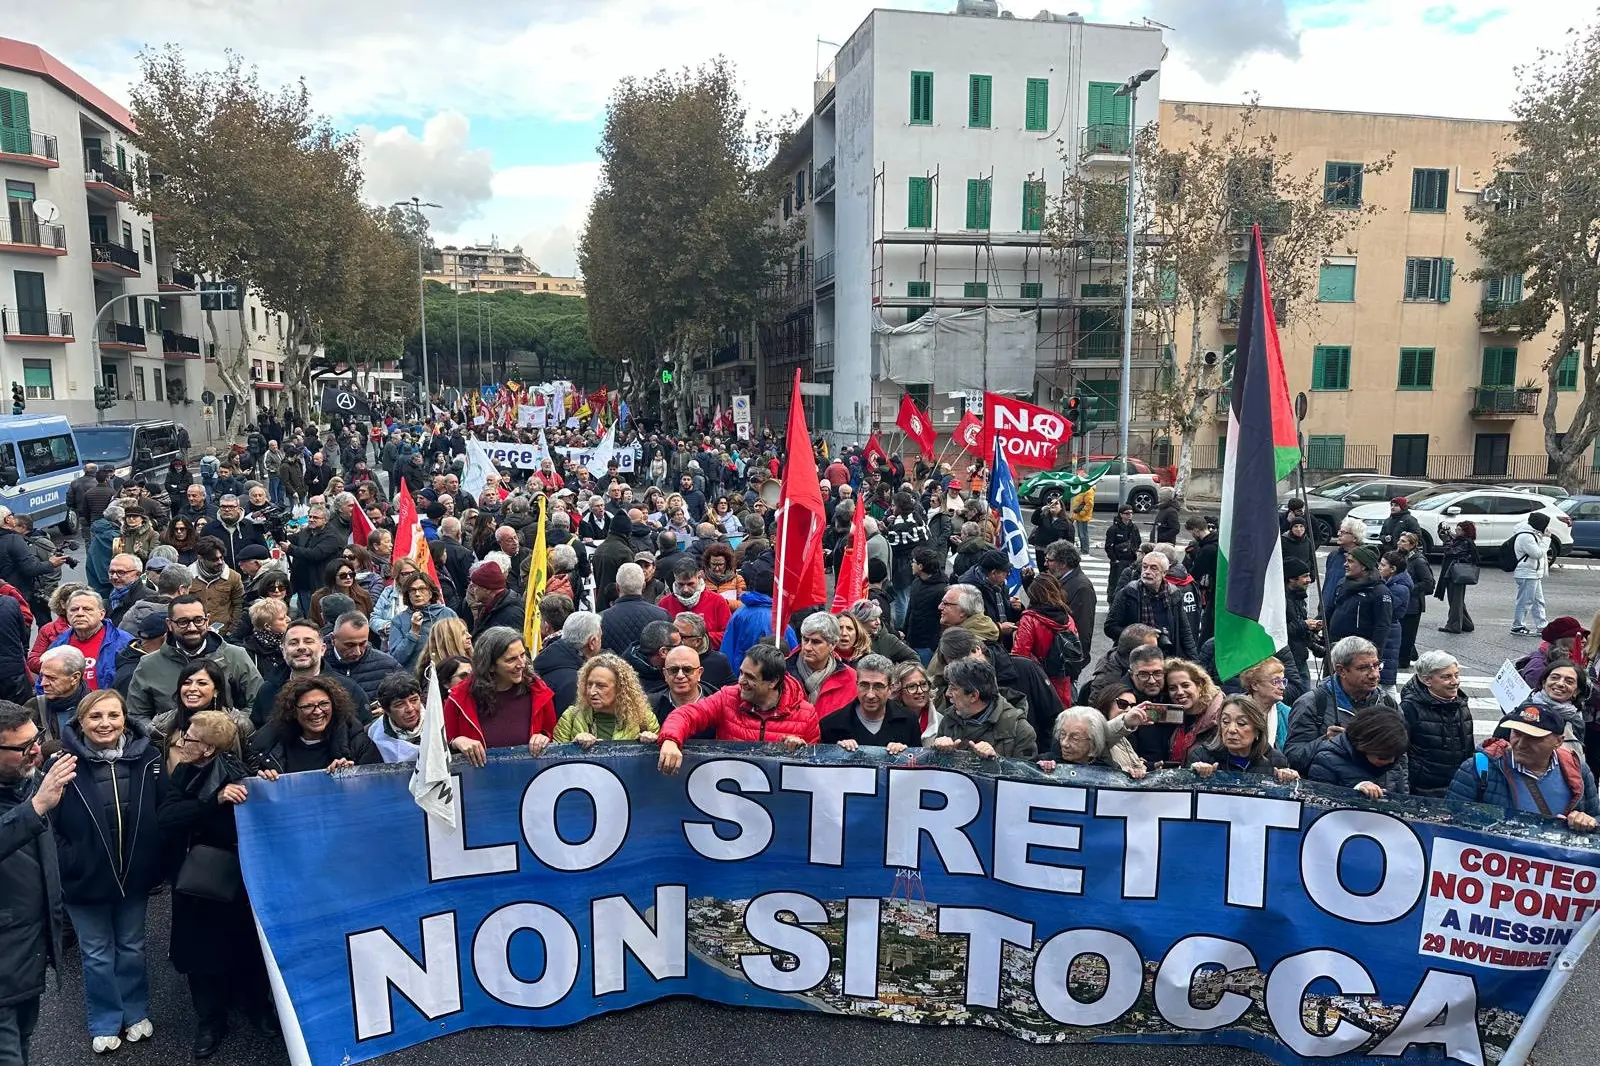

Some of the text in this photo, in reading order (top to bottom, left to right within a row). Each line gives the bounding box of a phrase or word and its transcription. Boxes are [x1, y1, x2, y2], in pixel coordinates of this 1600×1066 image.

[994, 405, 1065, 441] NO
[483, 447, 533, 464] vece
[29, 491, 59, 507] POLIZIA
[888, 525, 929, 546] ONT
[425, 757, 1428, 925] LO STRETTO
[1429, 871, 1484, 905] NO
[1460, 848, 1596, 893] CORTEO
[1439, 908, 1574, 946] A MESSIN
[1422, 933, 1446, 953] 29
[1449, 938, 1552, 967] NOVEMBRE
[345, 883, 1487, 1066] NON SI TOCCA
